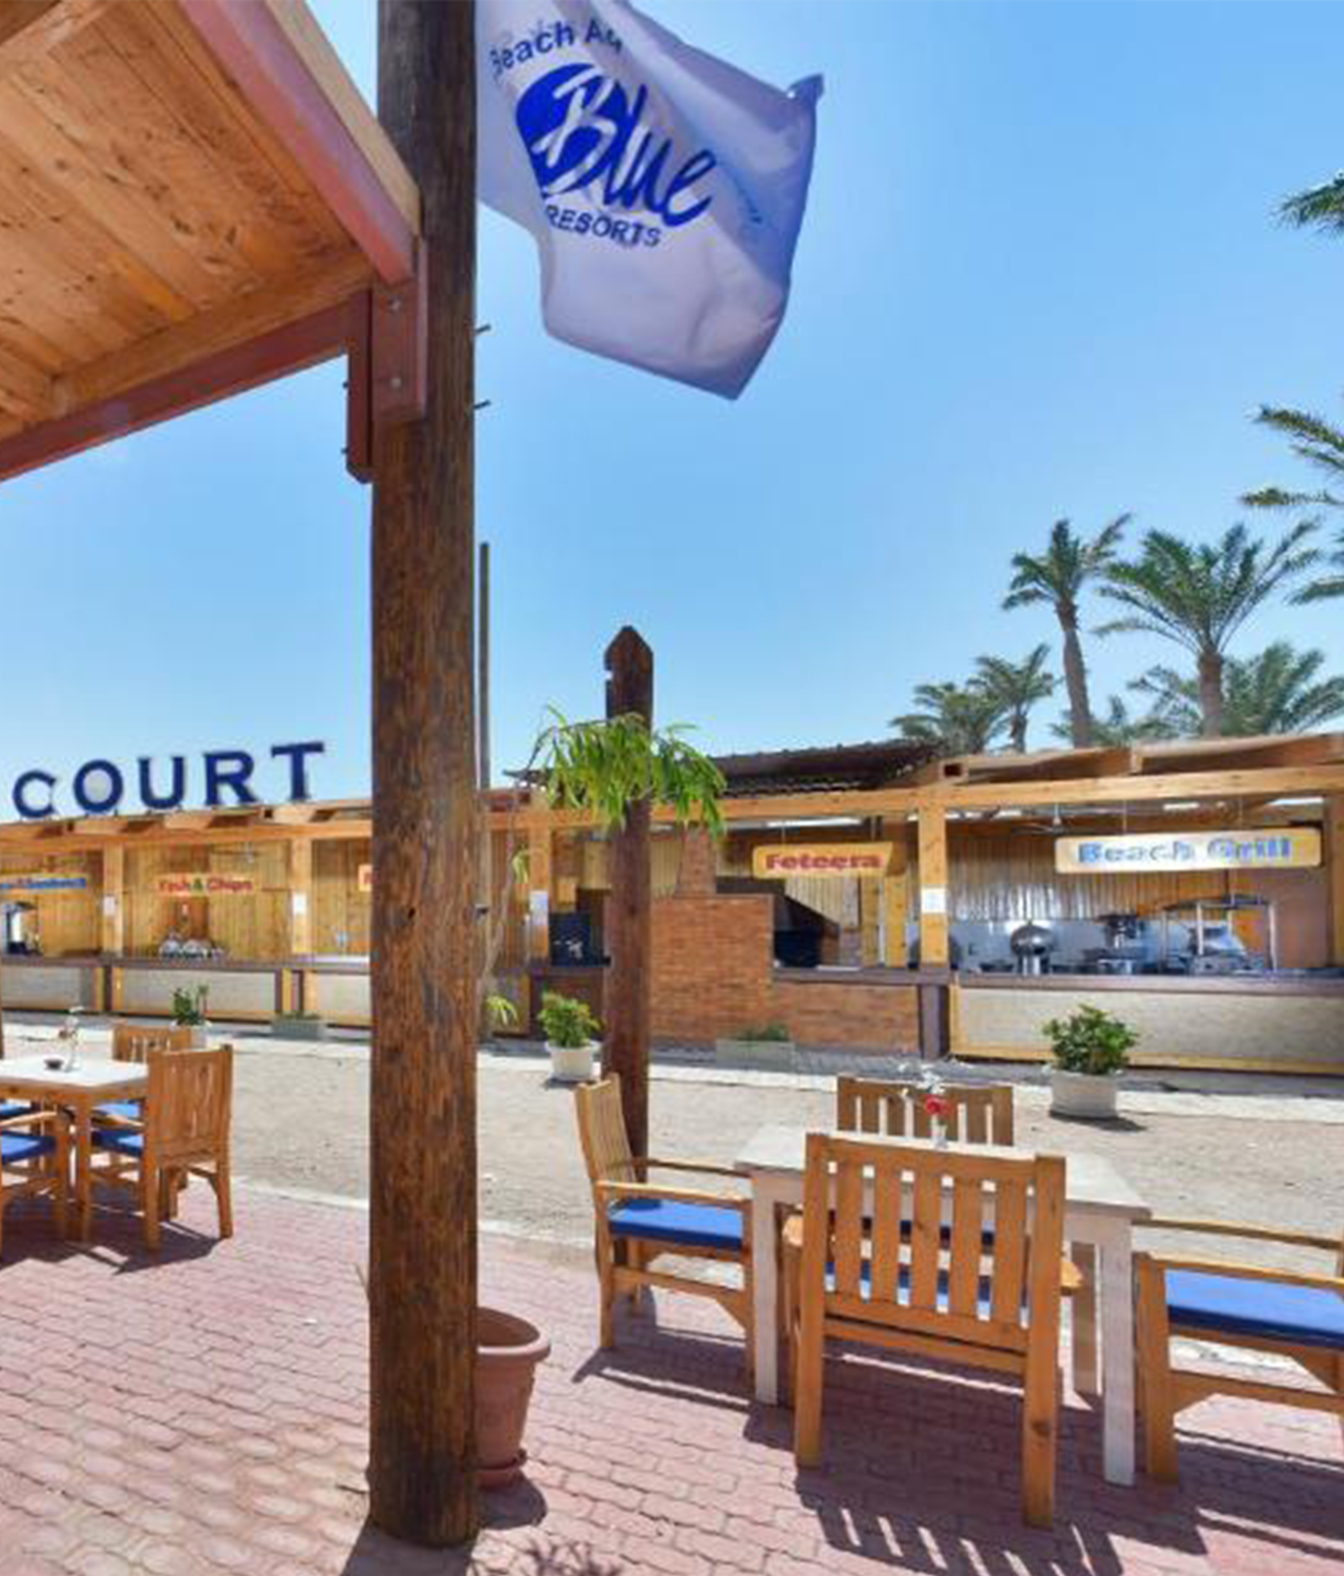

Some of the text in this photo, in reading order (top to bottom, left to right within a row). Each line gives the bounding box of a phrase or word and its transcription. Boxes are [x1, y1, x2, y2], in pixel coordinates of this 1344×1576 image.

[518, 63, 717, 227] Blue
[544, 204, 662, 248] RESORTS
[12, 741, 325, 819] COURT
[1078, 837, 1291, 864] Beach Grill
